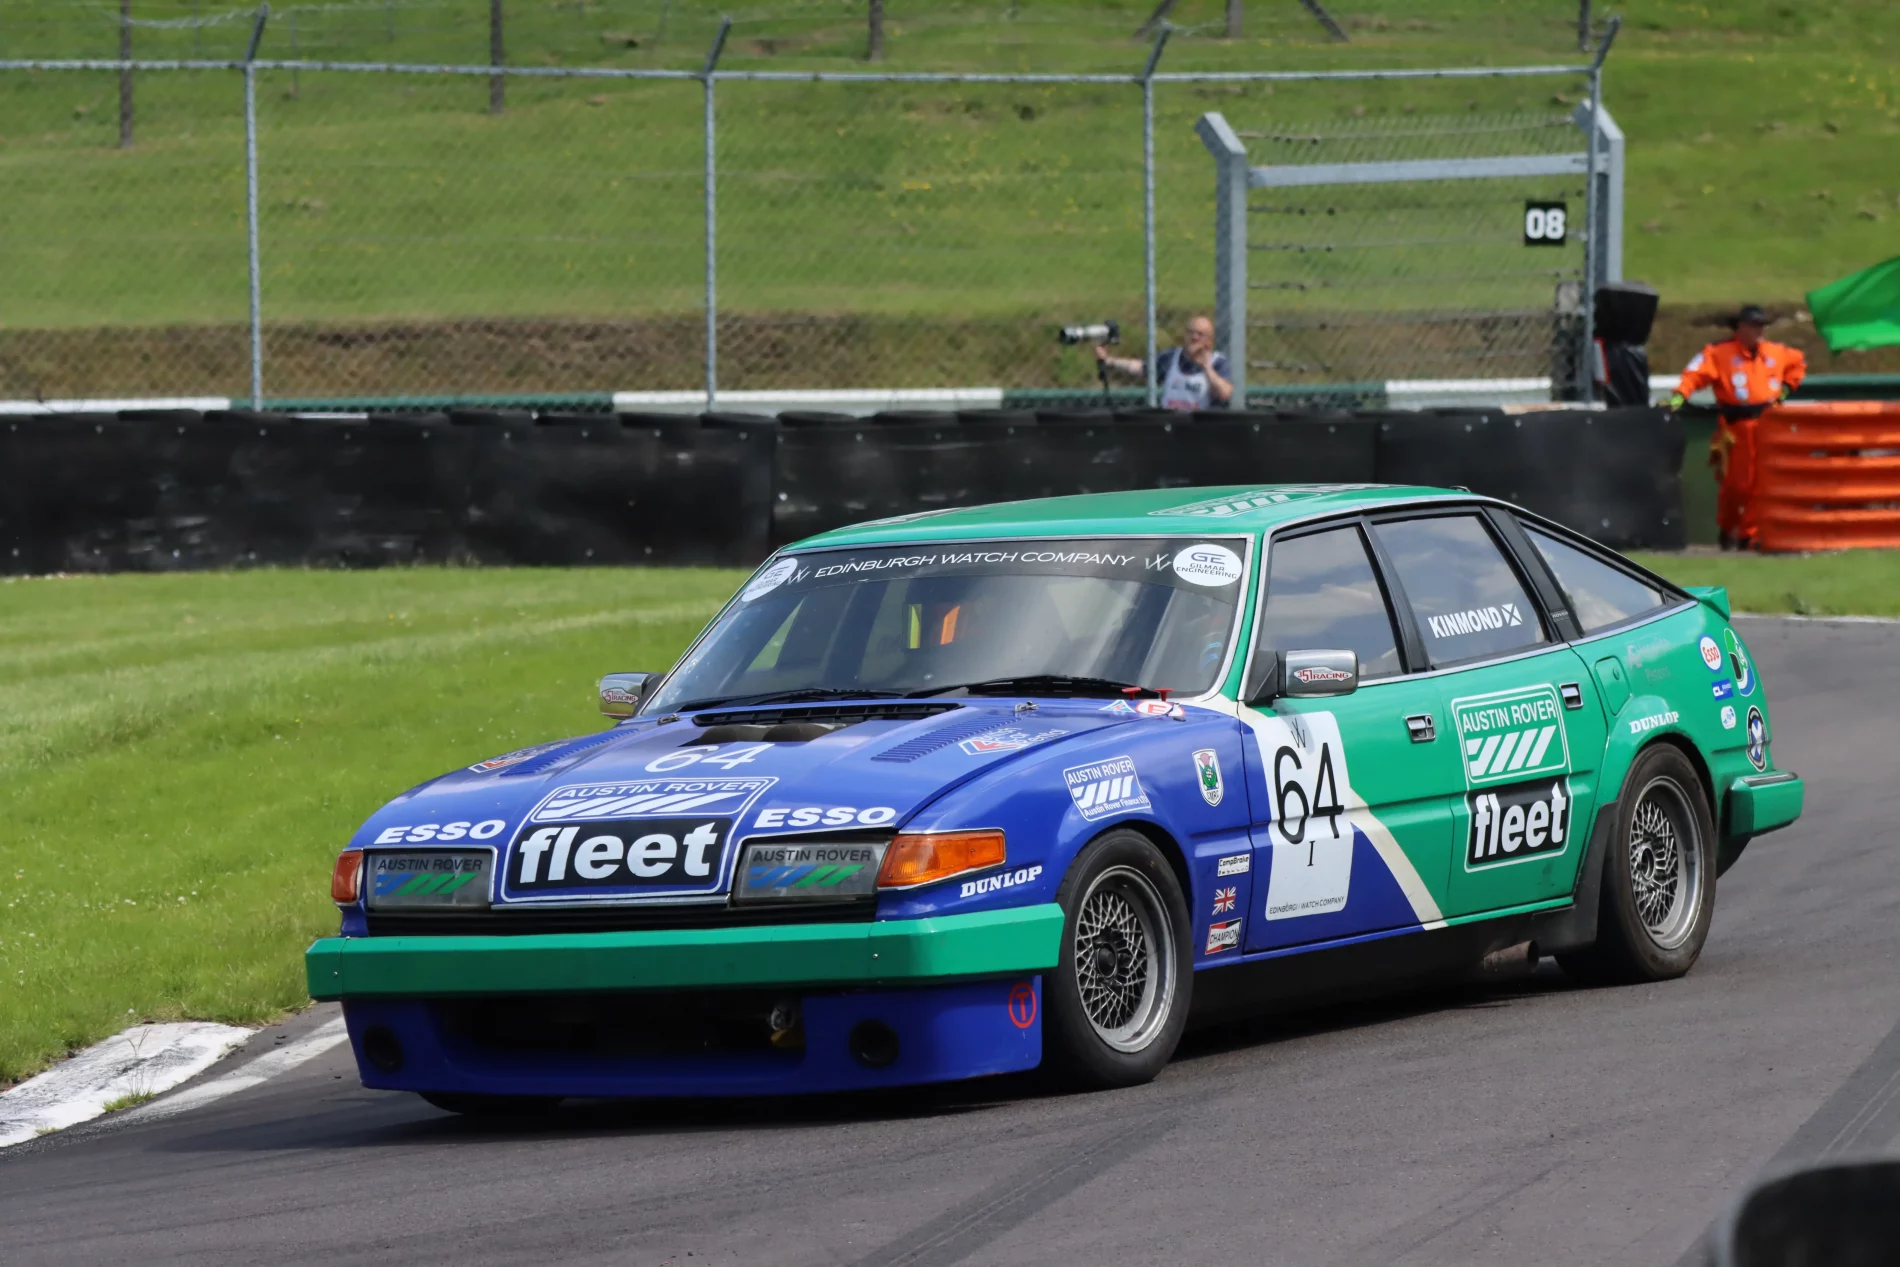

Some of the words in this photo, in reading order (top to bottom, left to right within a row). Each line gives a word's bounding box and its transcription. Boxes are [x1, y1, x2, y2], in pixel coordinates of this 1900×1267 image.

[1526, 208, 1566, 240] 08
[814, 554, 937, 578] EDINBURGH
[941, 551, 1018, 564] WATCH
[1021, 551, 1135, 566] COMPANY
[1175, 566, 1237, 580] ENGINEERING
[1189, 563, 1225, 572] GILMAR
[1427, 606, 1503, 638] KINMOND
[1313, 672, 1349, 680] RACING
[1462, 706, 1510, 733] AUSTIN
[1511, 699, 1557, 725] ROVER
[1629, 711, 1679, 734] DUNLOP
[644, 743, 776, 772] 64
[1067, 766, 1102, 785] AUSTIN
[1101, 760, 1134, 777] ROVER
[556, 783, 661, 799] AUSTIN
[663, 781, 762, 792] ROVER
[1274, 742, 1344, 845] 64
[753, 807, 896, 828] ESSO
[1084, 803, 1106, 817] Austin
[1104, 801, 1122, 811] Rover
[1474, 781, 1567, 859] fleet
[373, 819, 506, 844] ESSO
[377, 859, 430, 871] AUSTIN
[432, 859, 483, 871] ROVER
[519, 822, 718, 884] fleet
[752, 849, 811, 862] AUSTIN
[815, 849, 872, 862] ROVER
[960, 865, 1043, 898] DUNLOP
[1300, 900, 1319, 910] WATCH
[1319, 896, 1345, 907] COMPANY
